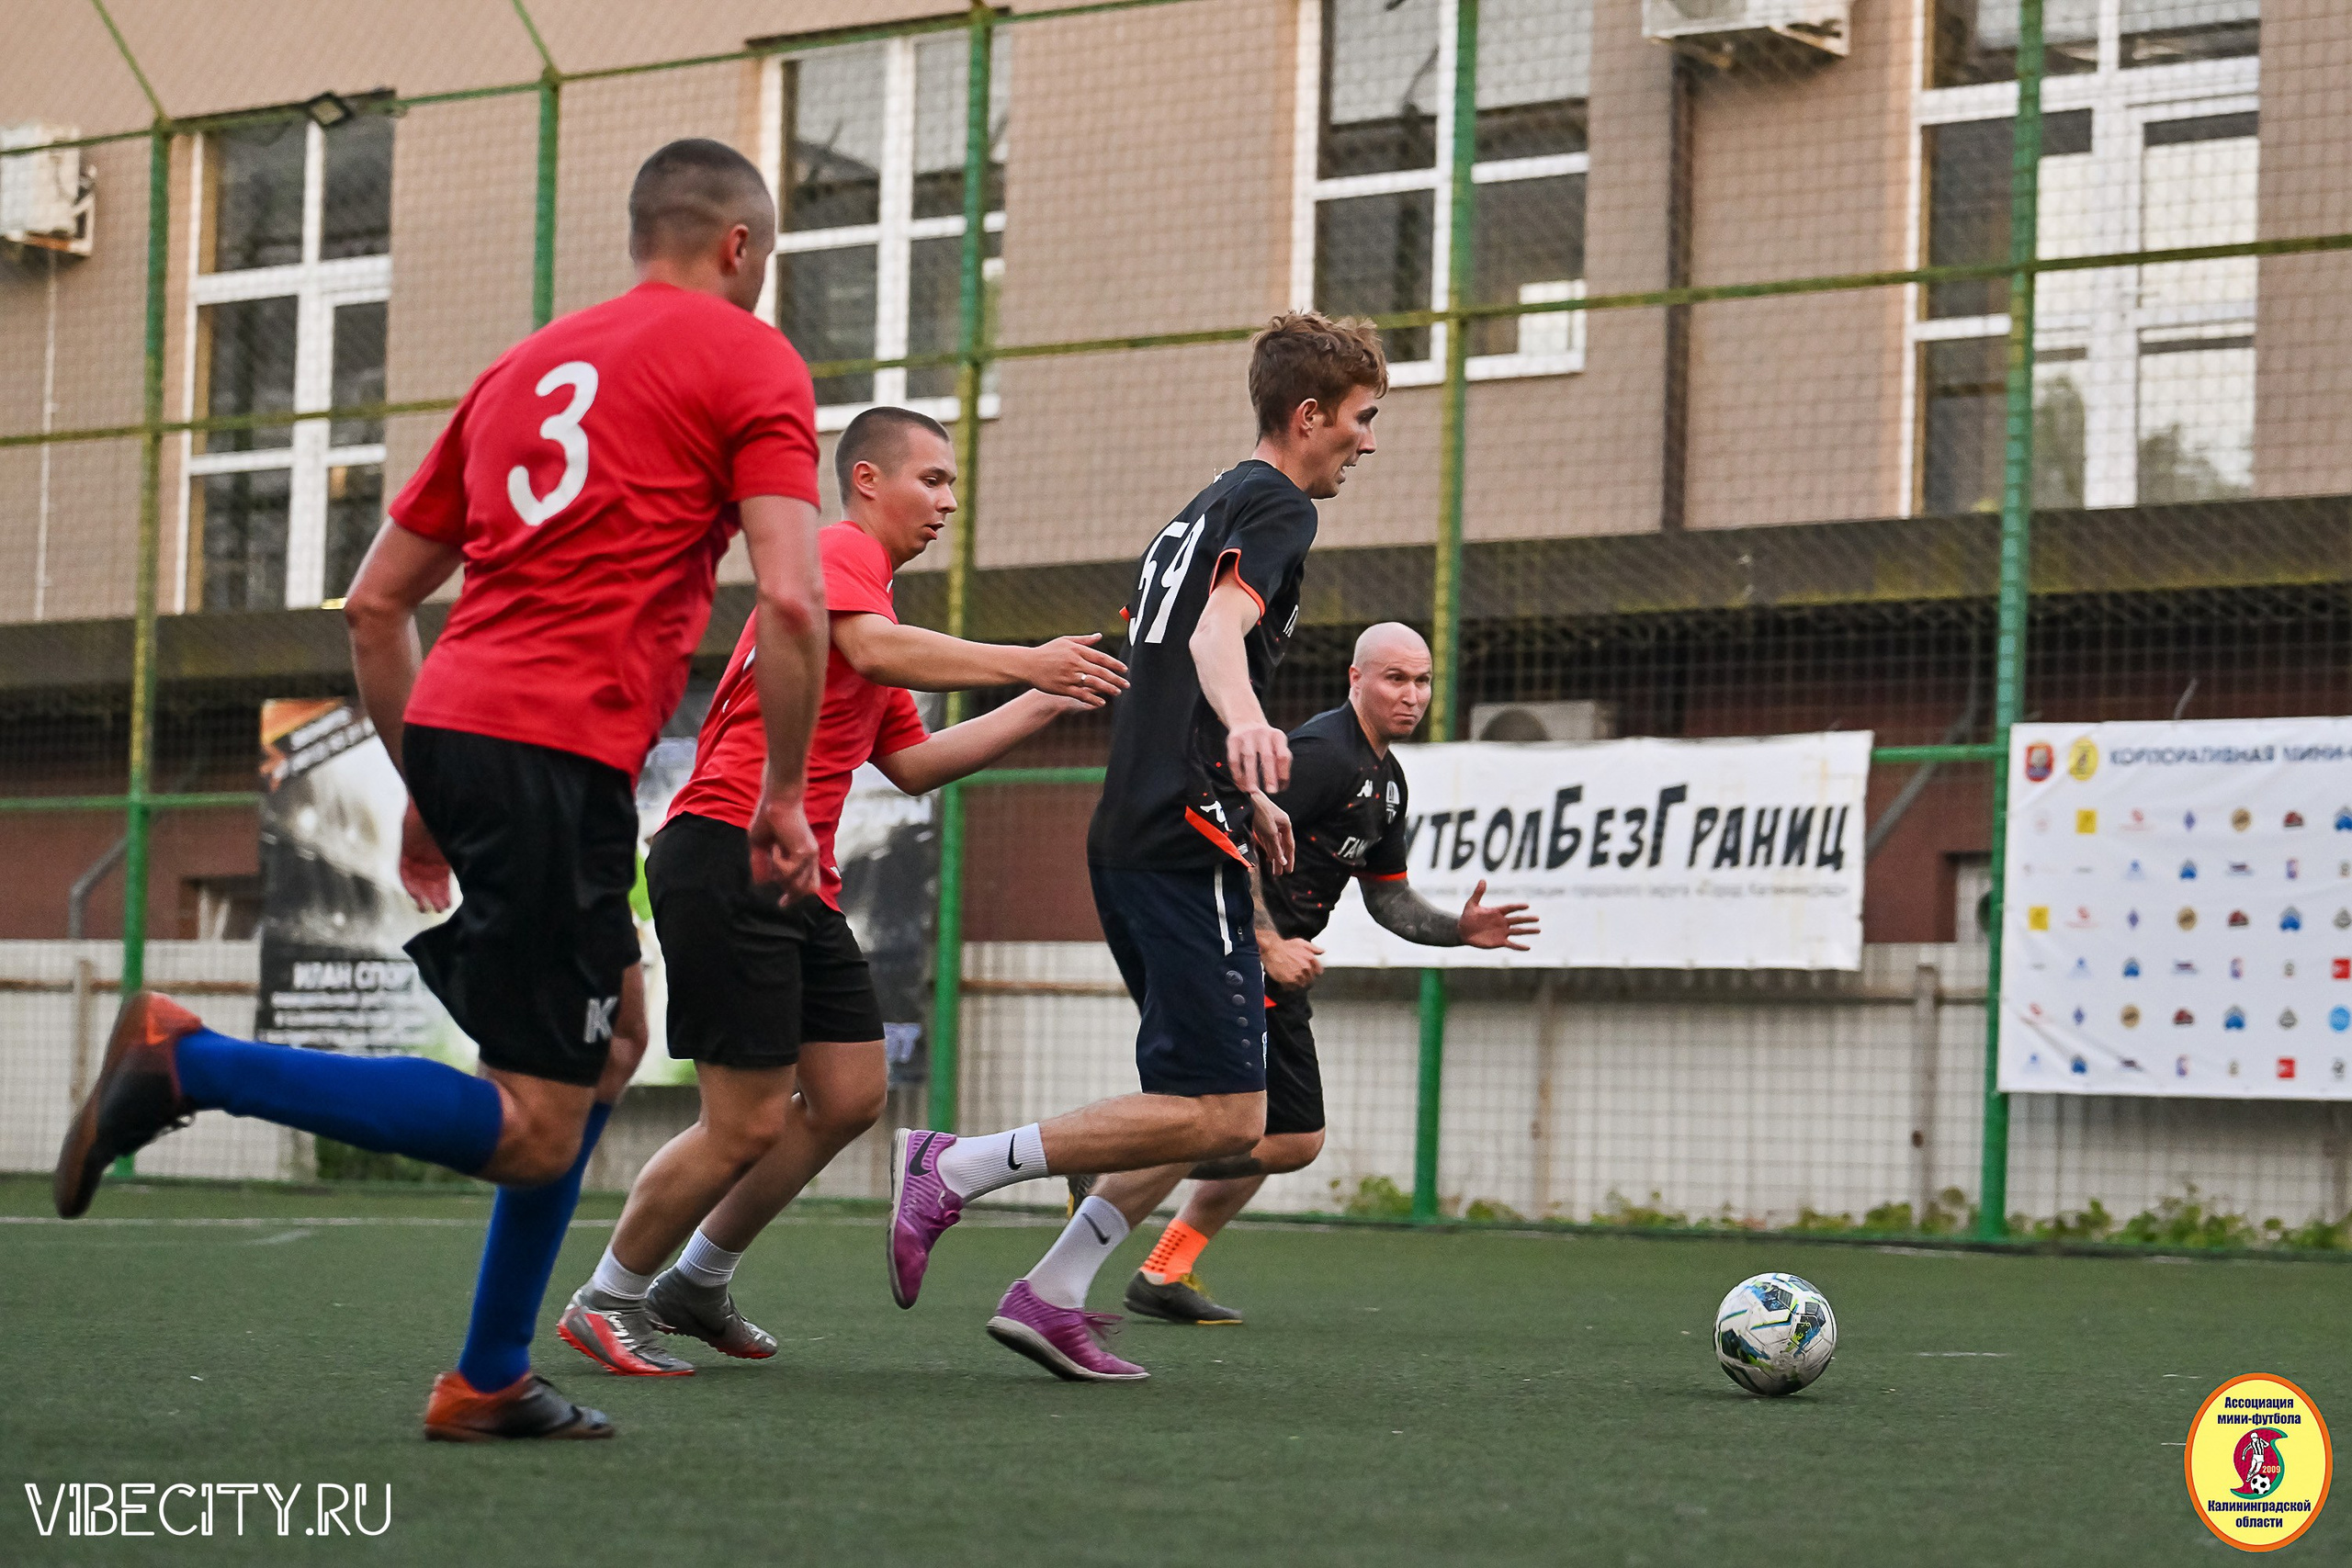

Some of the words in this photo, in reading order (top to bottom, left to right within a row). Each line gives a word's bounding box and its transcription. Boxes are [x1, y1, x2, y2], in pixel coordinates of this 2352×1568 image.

[507, 360, 599, 521] 3
[1128, 513, 1205, 647] 59
[2283, 745, 2352, 763] МИНИ-
